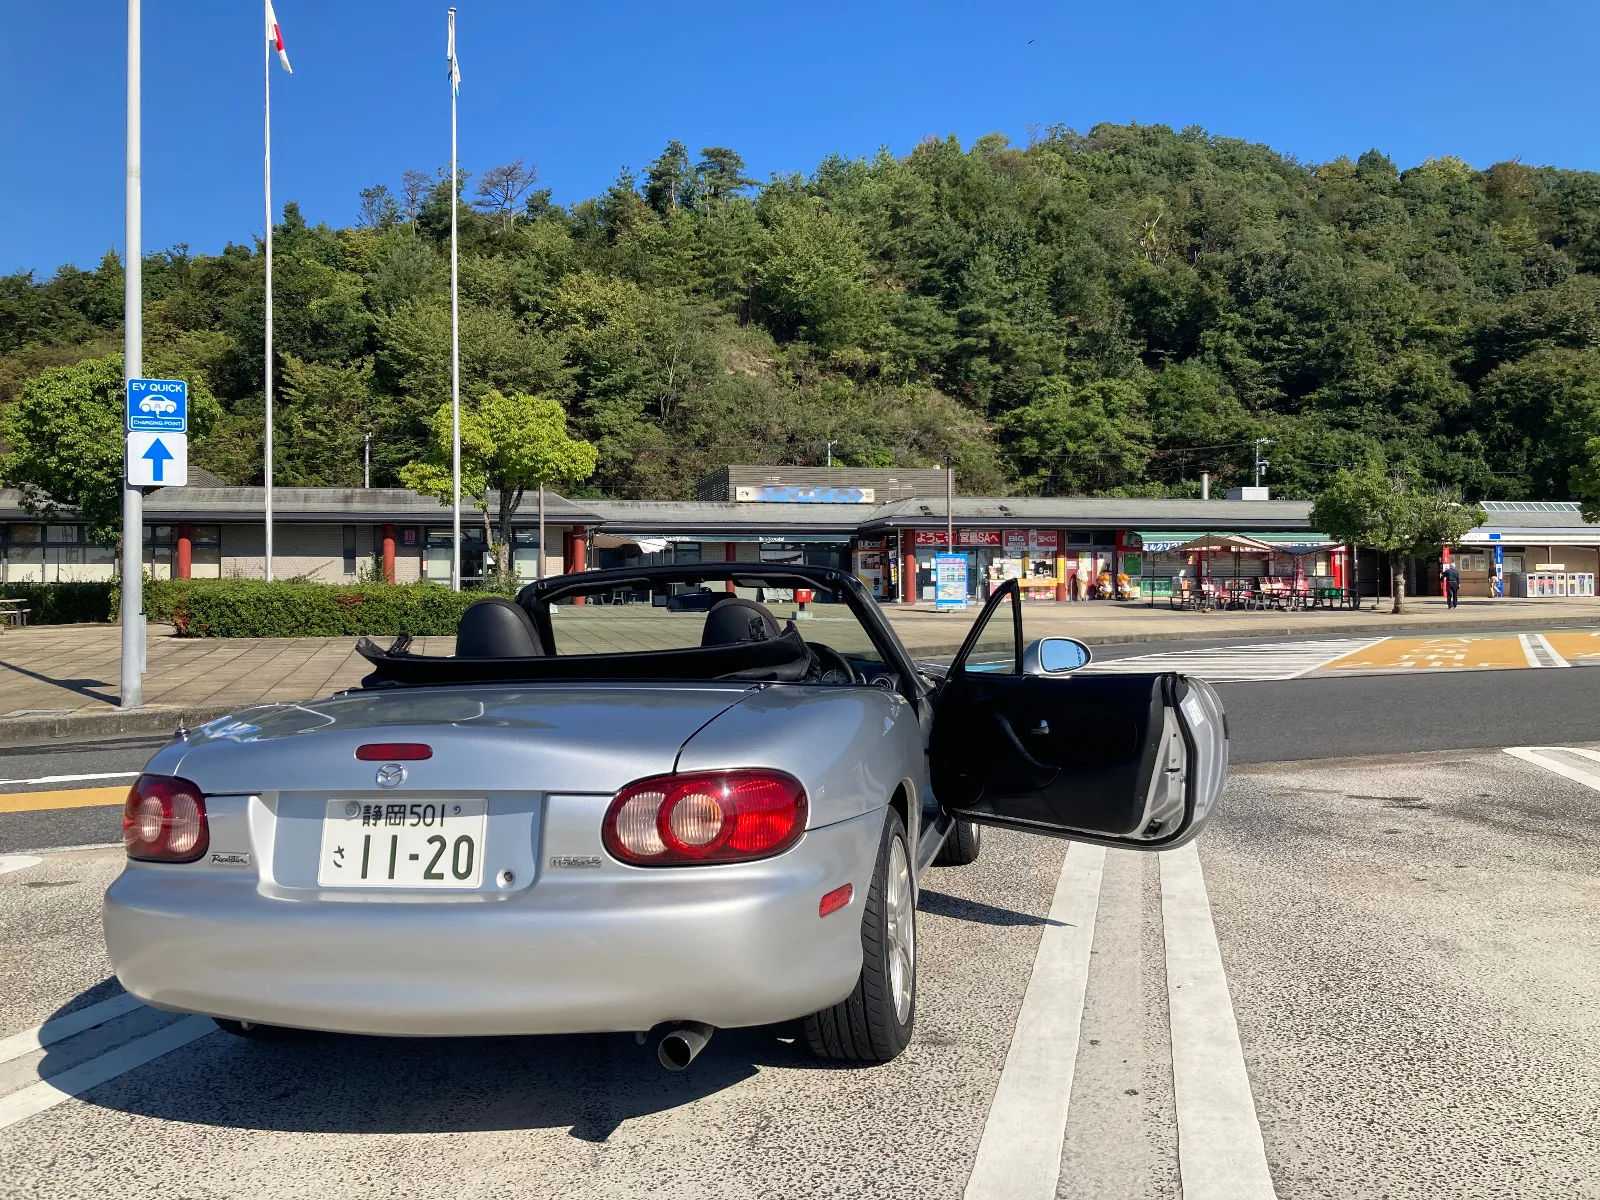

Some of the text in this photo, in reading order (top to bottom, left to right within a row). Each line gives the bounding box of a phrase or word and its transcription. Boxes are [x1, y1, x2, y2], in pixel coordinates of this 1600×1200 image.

[132, 382, 183, 393] EV QUICK
[333, 834, 475, 880] さ 11-20
